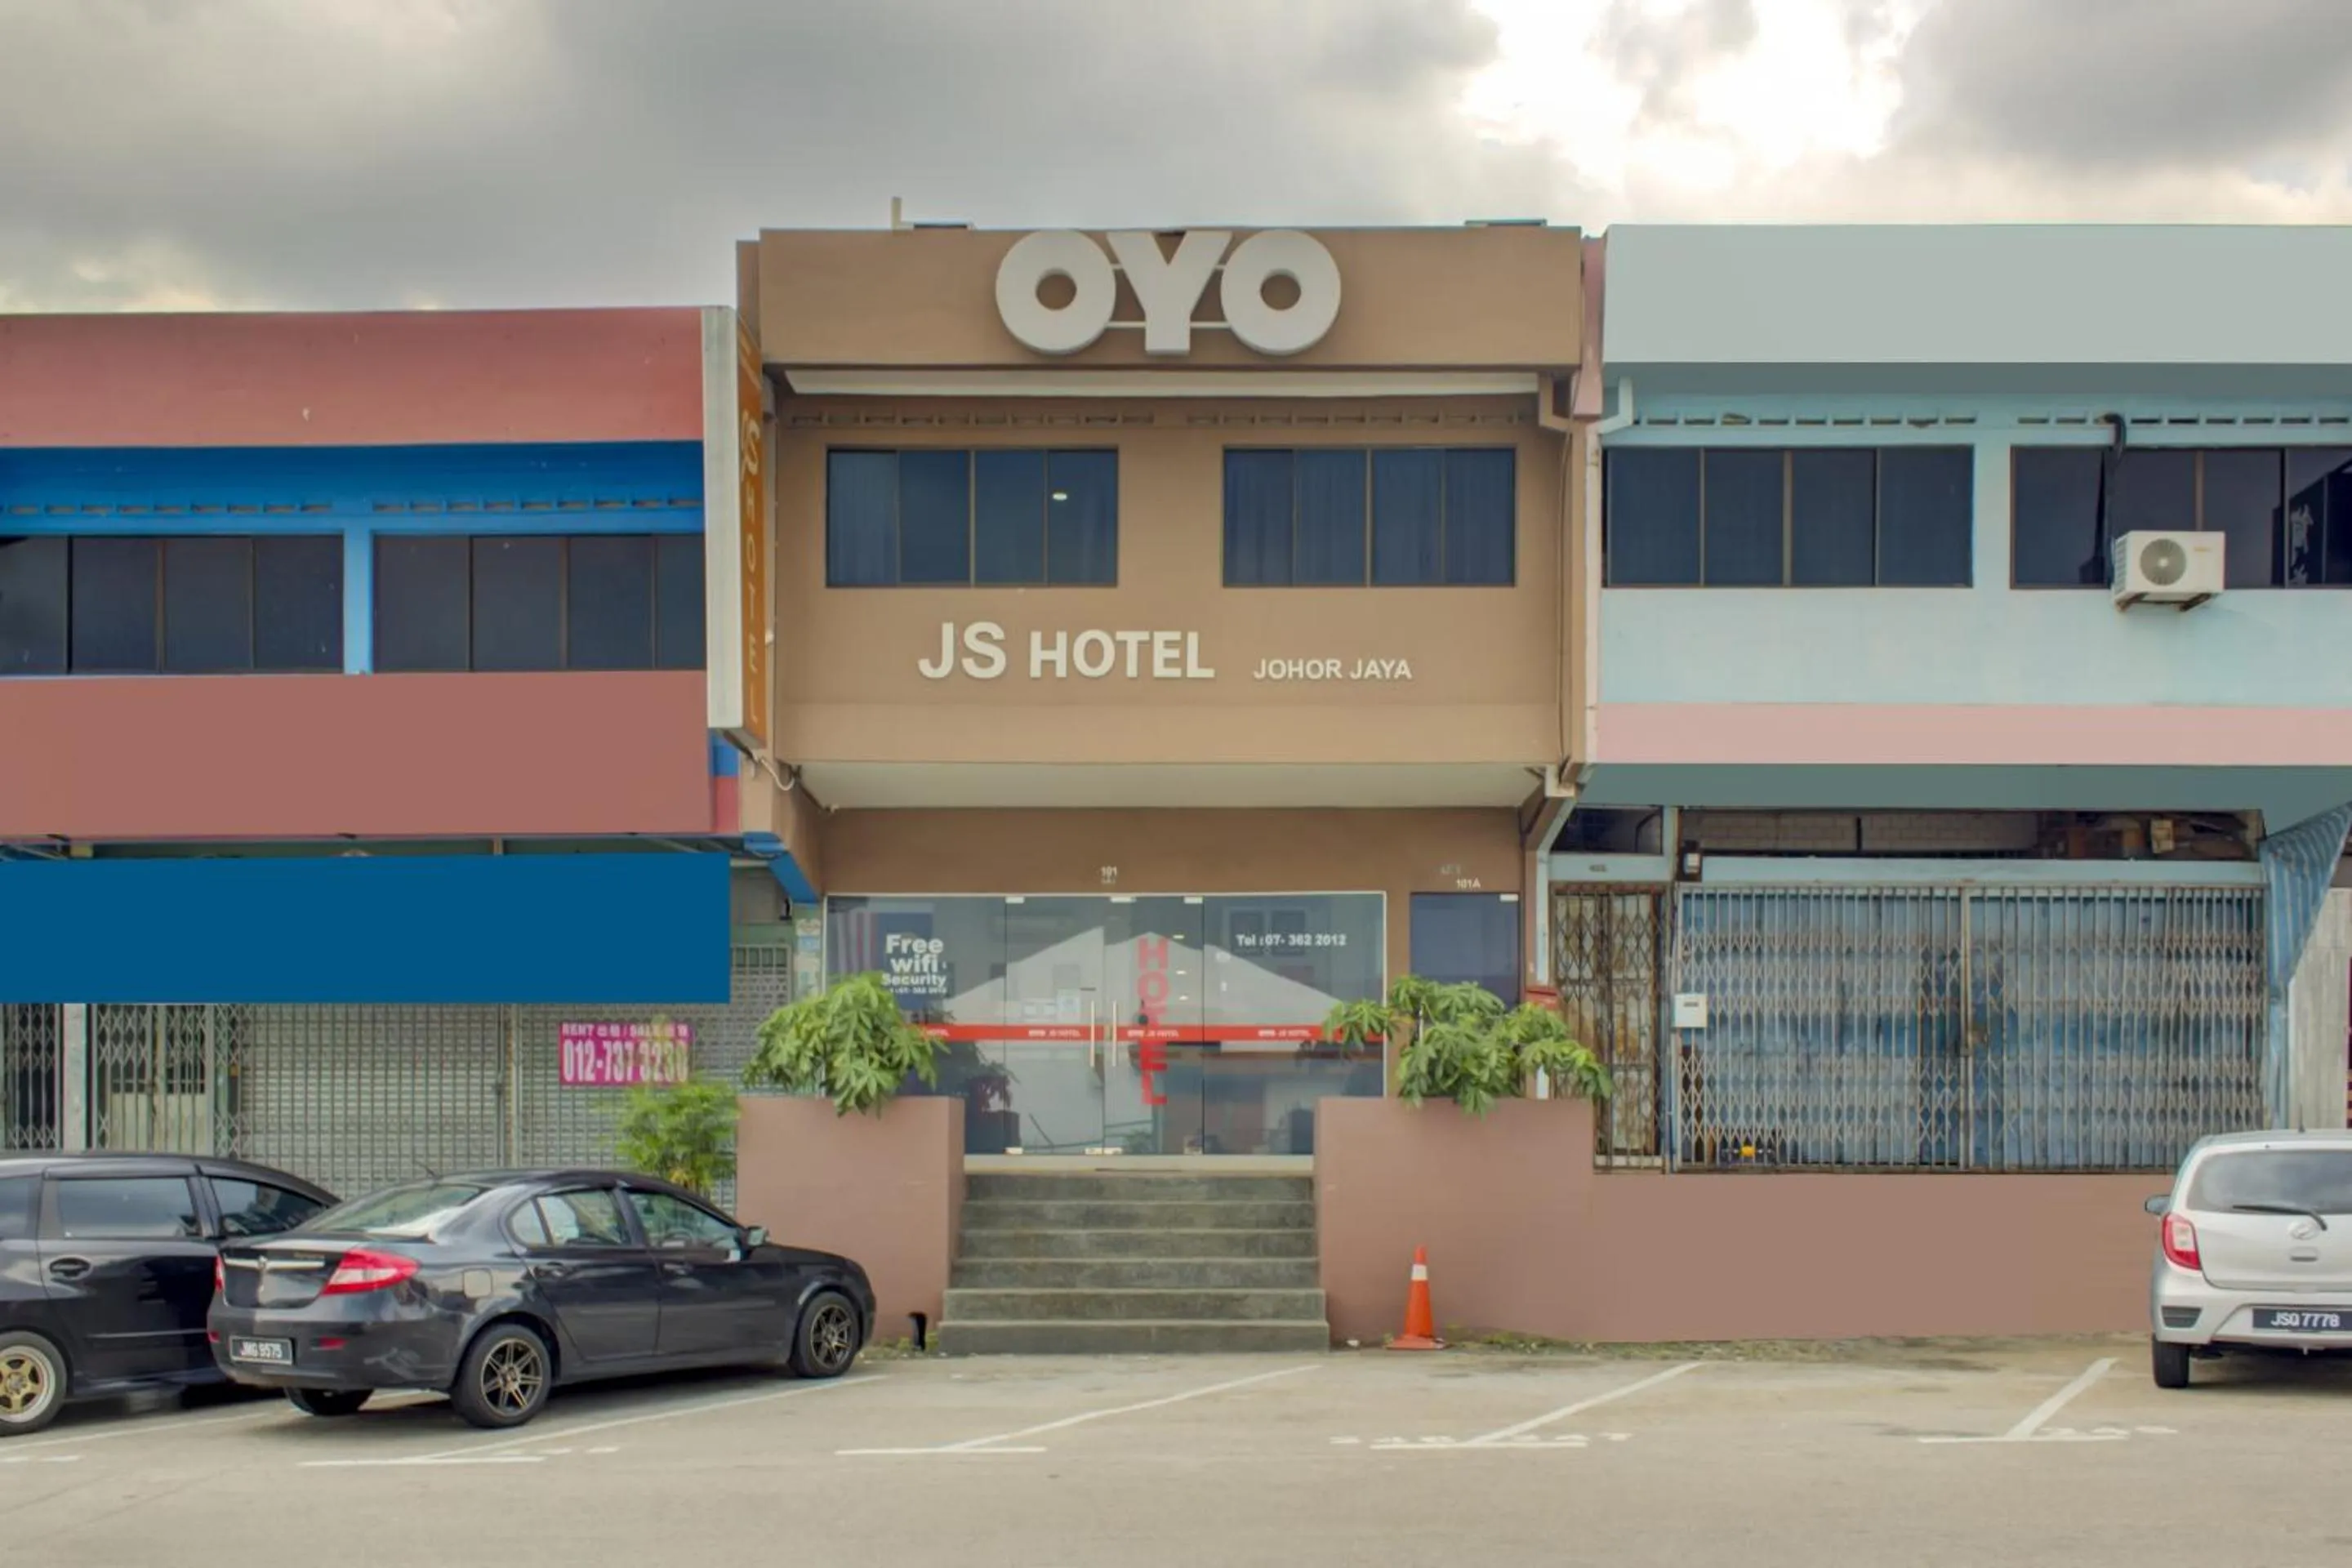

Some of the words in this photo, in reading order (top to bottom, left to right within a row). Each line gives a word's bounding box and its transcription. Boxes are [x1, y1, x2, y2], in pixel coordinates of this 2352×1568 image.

[996, 229, 1342, 356] OYO
[743, 480, 760, 725] HOTEL
[918, 622, 1006, 679] JS
[1029, 630, 1215, 679] HOTEL
[1253, 658, 1343, 680] JOHOR
[1349, 658, 1413, 680] JAYA
[1456, 877, 1481, 889] 101A
[885, 934, 944, 954] Free
[1236, 933, 1256, 946] Tel
[1315, 933, 1347, 946] 2012
[890, 953, 938, 973] wifi
[882, 973, 947, 987] Security
[2301, 1312, 2341, 1328] 7778
